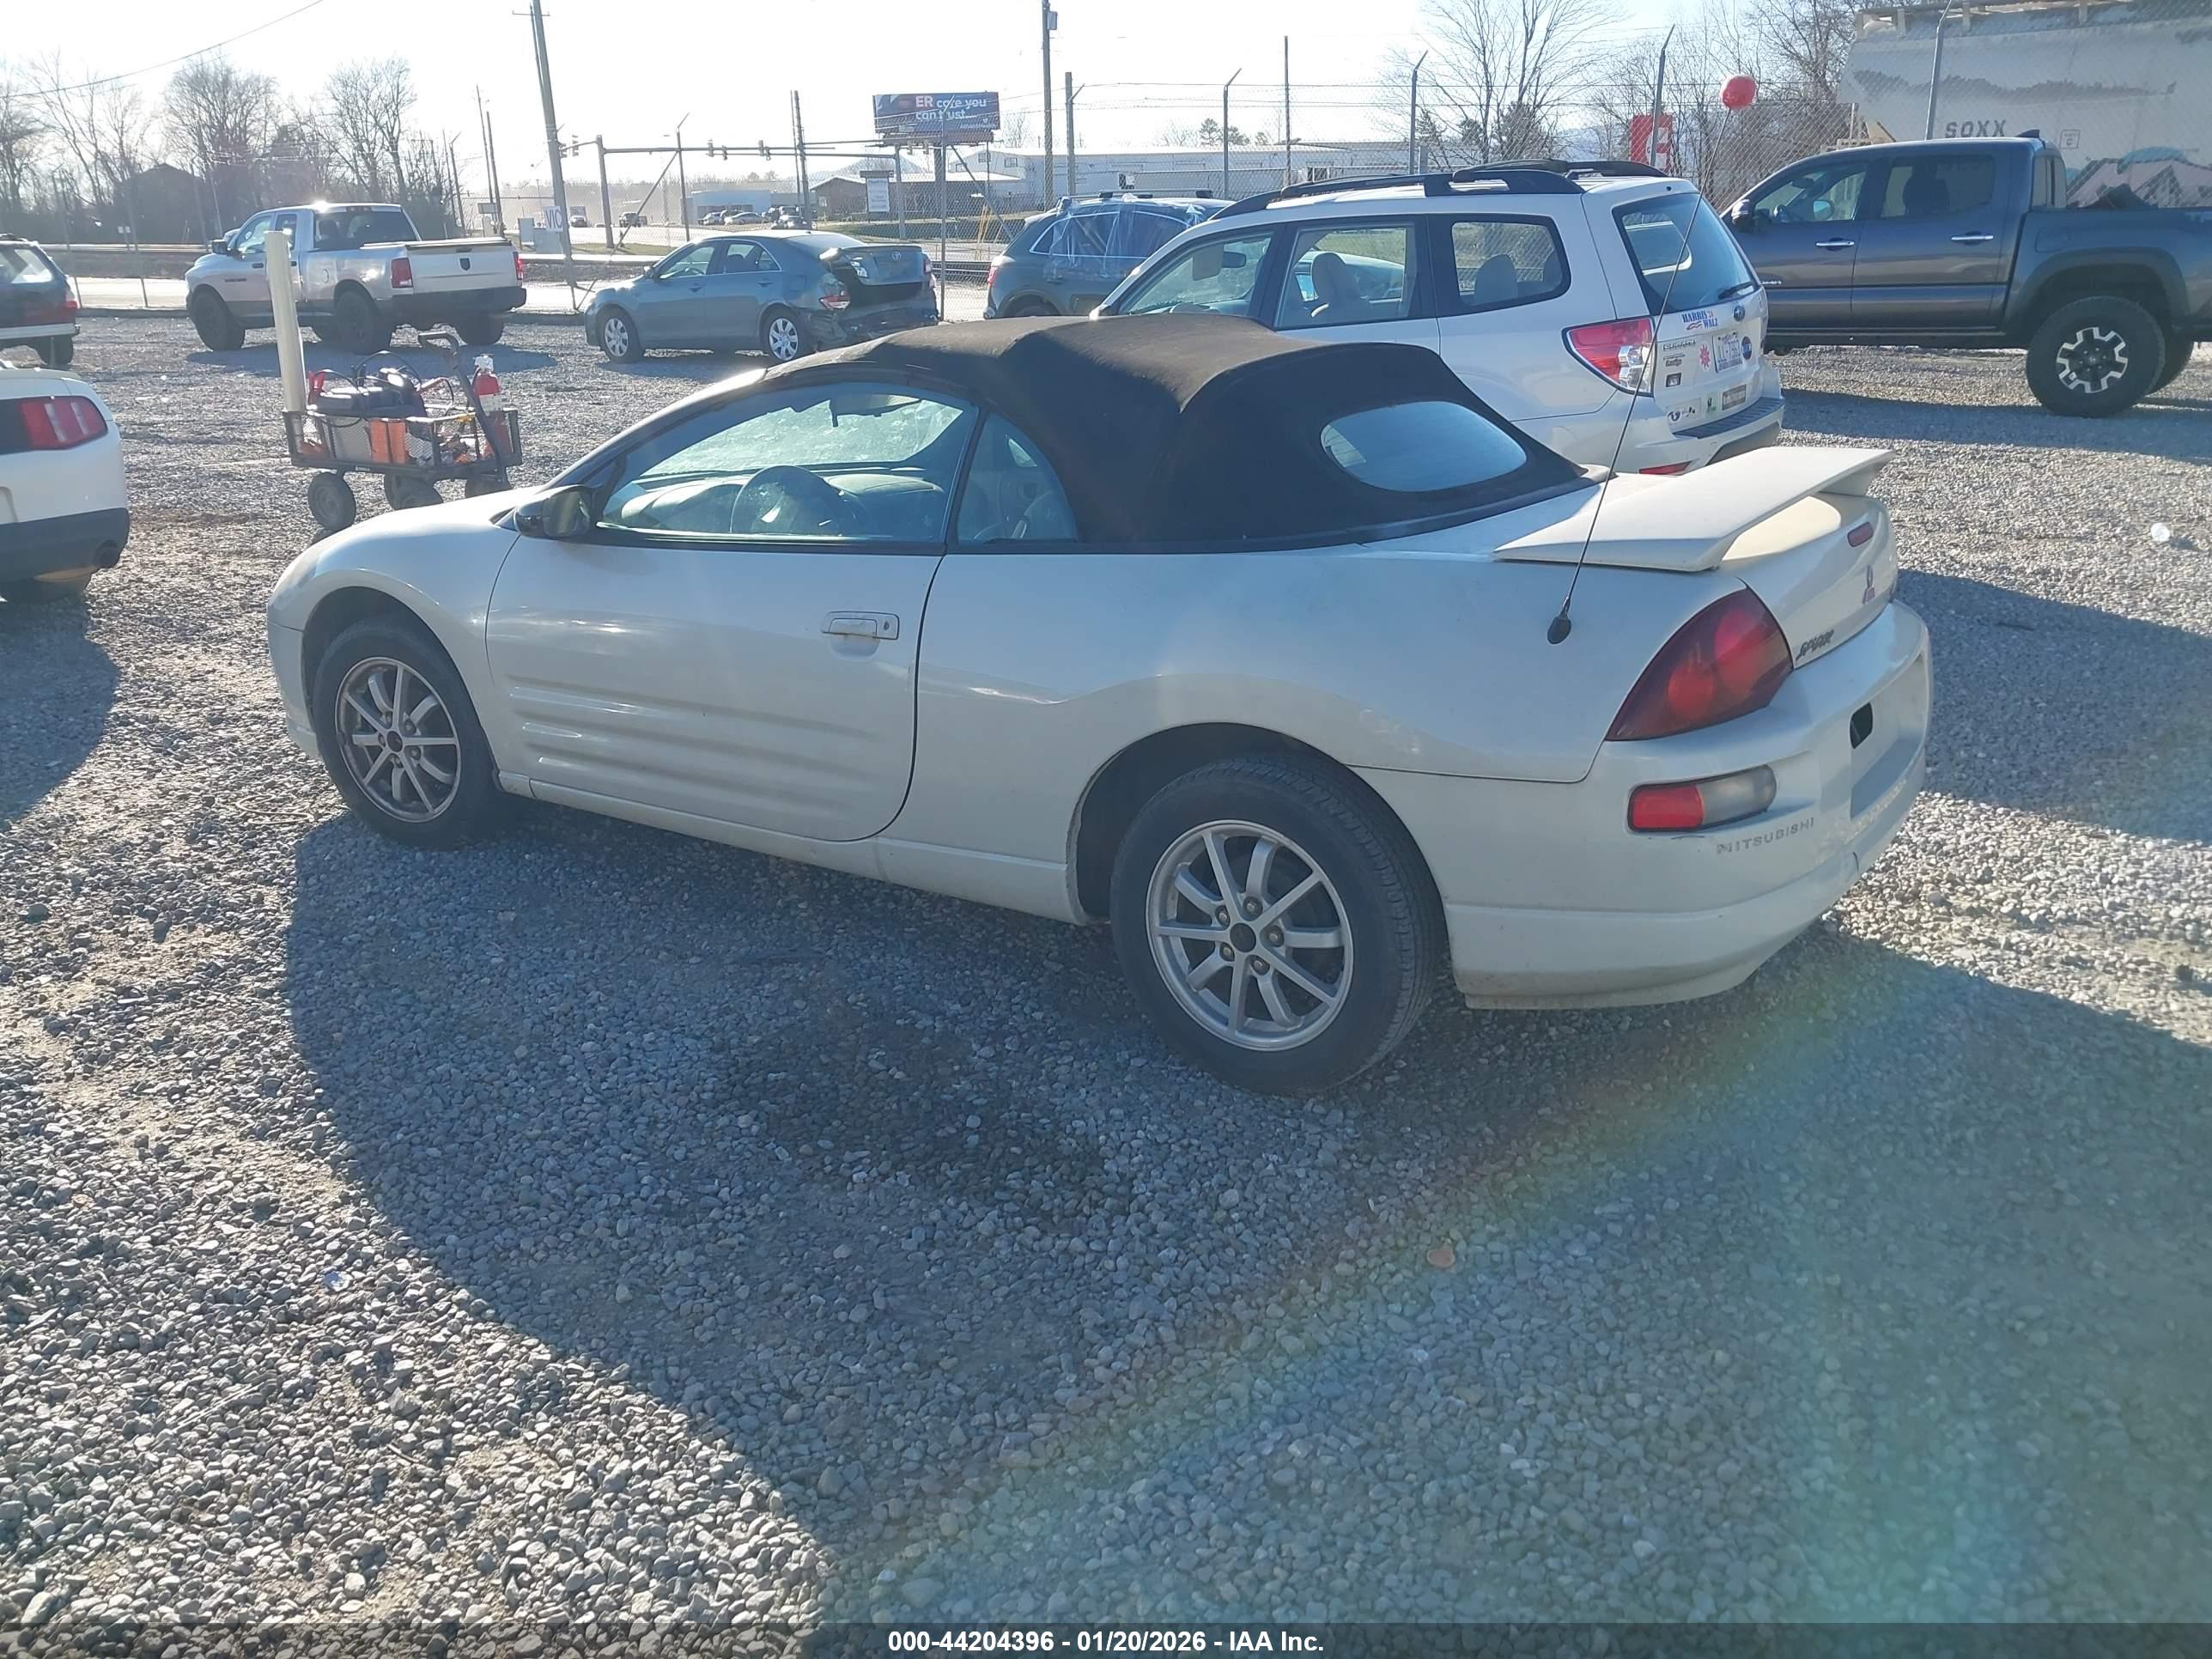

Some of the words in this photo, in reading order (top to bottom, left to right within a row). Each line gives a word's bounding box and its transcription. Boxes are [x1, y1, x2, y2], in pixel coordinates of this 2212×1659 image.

[915, 96, 933, 108] ER
[965, 98, 987, 109] you
[915, 111, 936, 120] can
[1944, 119, 2007, 138] SOXX
[1681, 310, 1708, 324] HARRIS
[1716, 817, 1814, 854] MITSUBISHI
